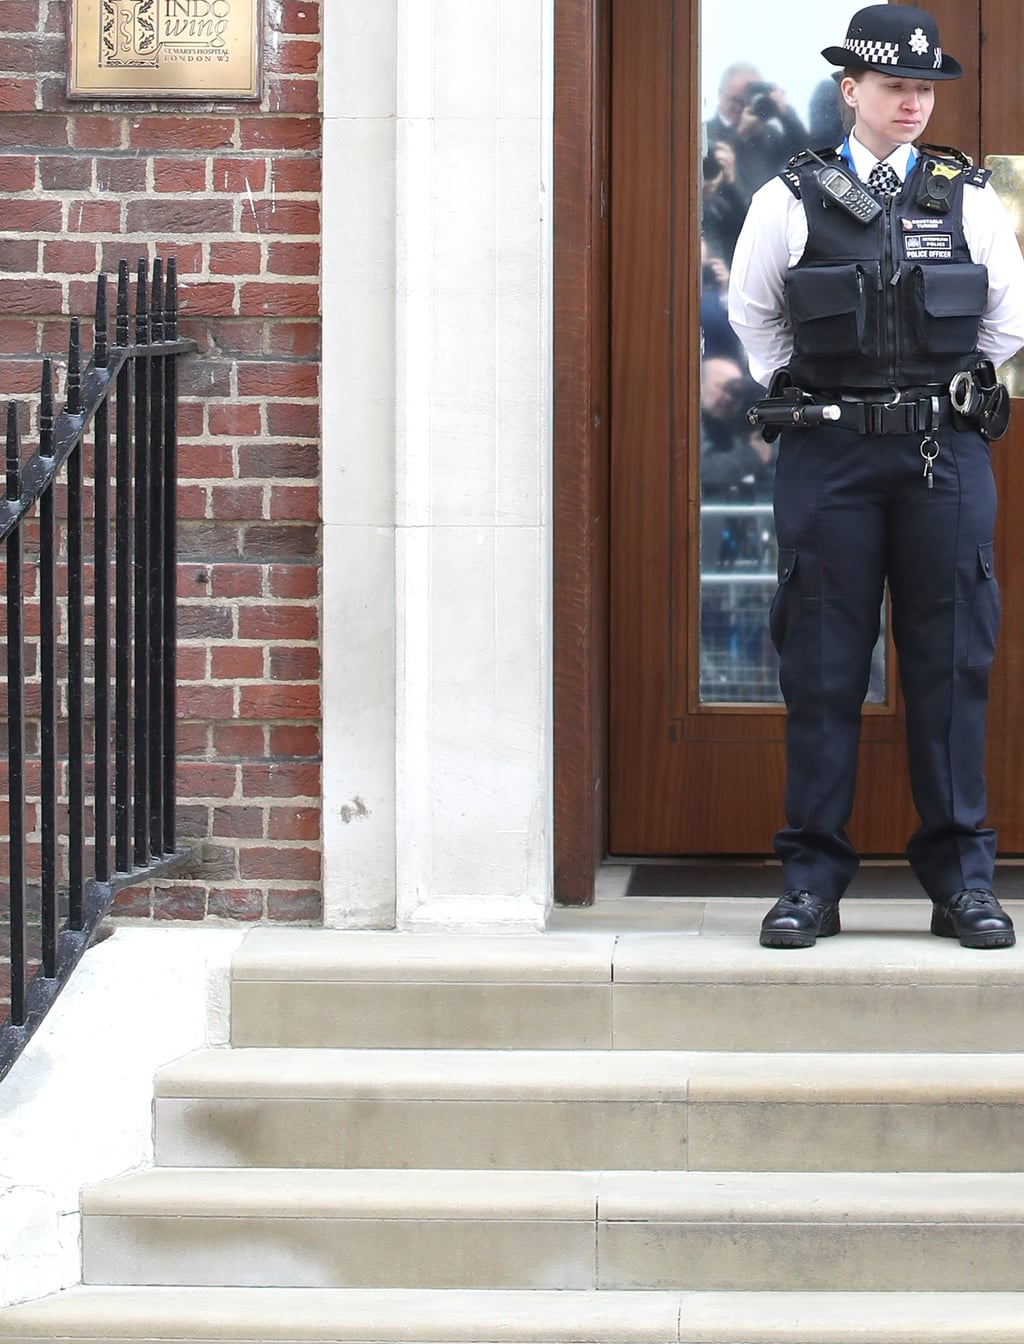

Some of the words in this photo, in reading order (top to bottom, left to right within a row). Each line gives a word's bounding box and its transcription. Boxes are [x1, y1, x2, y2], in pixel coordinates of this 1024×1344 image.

[164, 18, 229, 48] wing
[906, 250, 928, 258] POLICE
[928, 250, 951, 258] OFFICER
